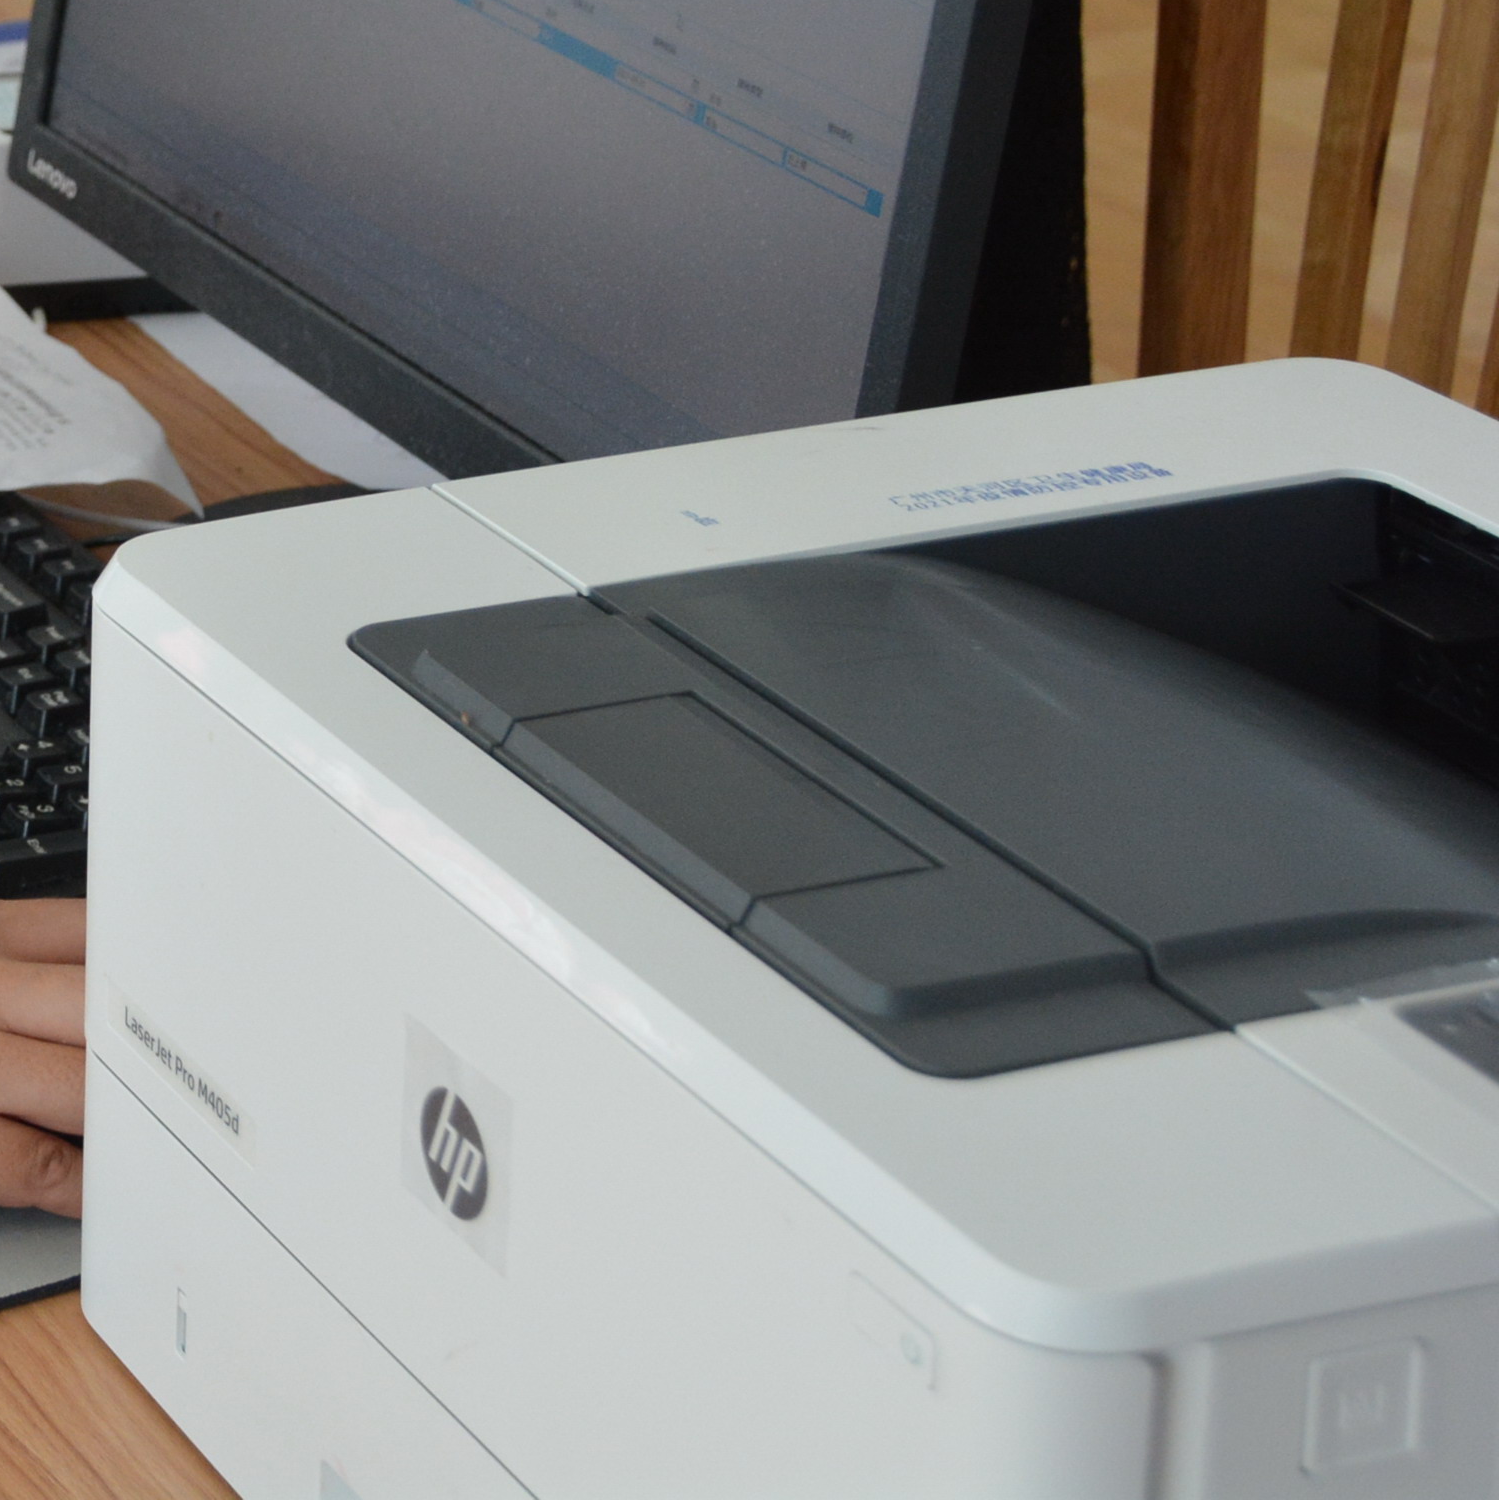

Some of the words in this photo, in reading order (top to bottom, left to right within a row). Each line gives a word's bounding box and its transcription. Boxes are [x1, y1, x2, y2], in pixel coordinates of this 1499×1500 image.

[124, 1004, 173, 1071] LaserJet
[175, 1054, 196, 1092] Pro
[197, 1077, 240, 1136] M405d
[422, 1087, 487, 1216] hp
